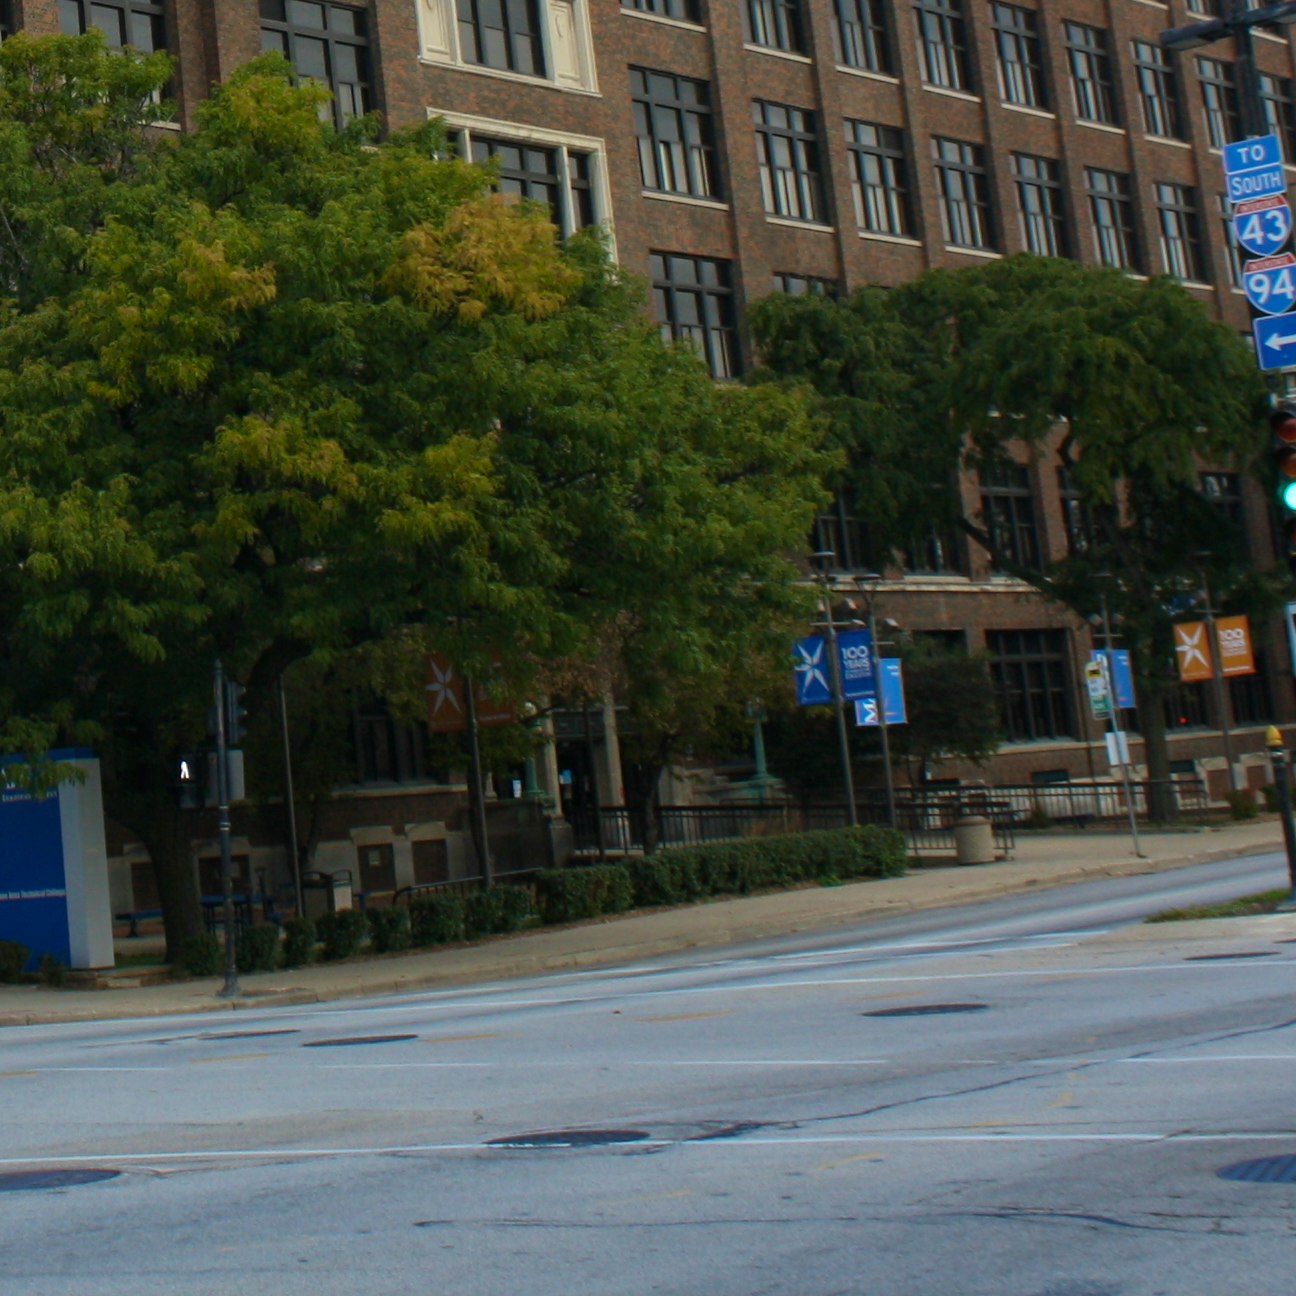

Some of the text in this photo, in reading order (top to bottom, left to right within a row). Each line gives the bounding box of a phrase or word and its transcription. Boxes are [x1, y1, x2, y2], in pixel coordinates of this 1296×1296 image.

[1237, 145, 1265, 163] TO
[1232, 171, 1281, 196] SOUTH
[1242, 210, 1287, 244] 43
[1249, 268, 1294, 304] 94
[1217, 628, 1244, 641] 100
[842, 646, 869, 659] 100
